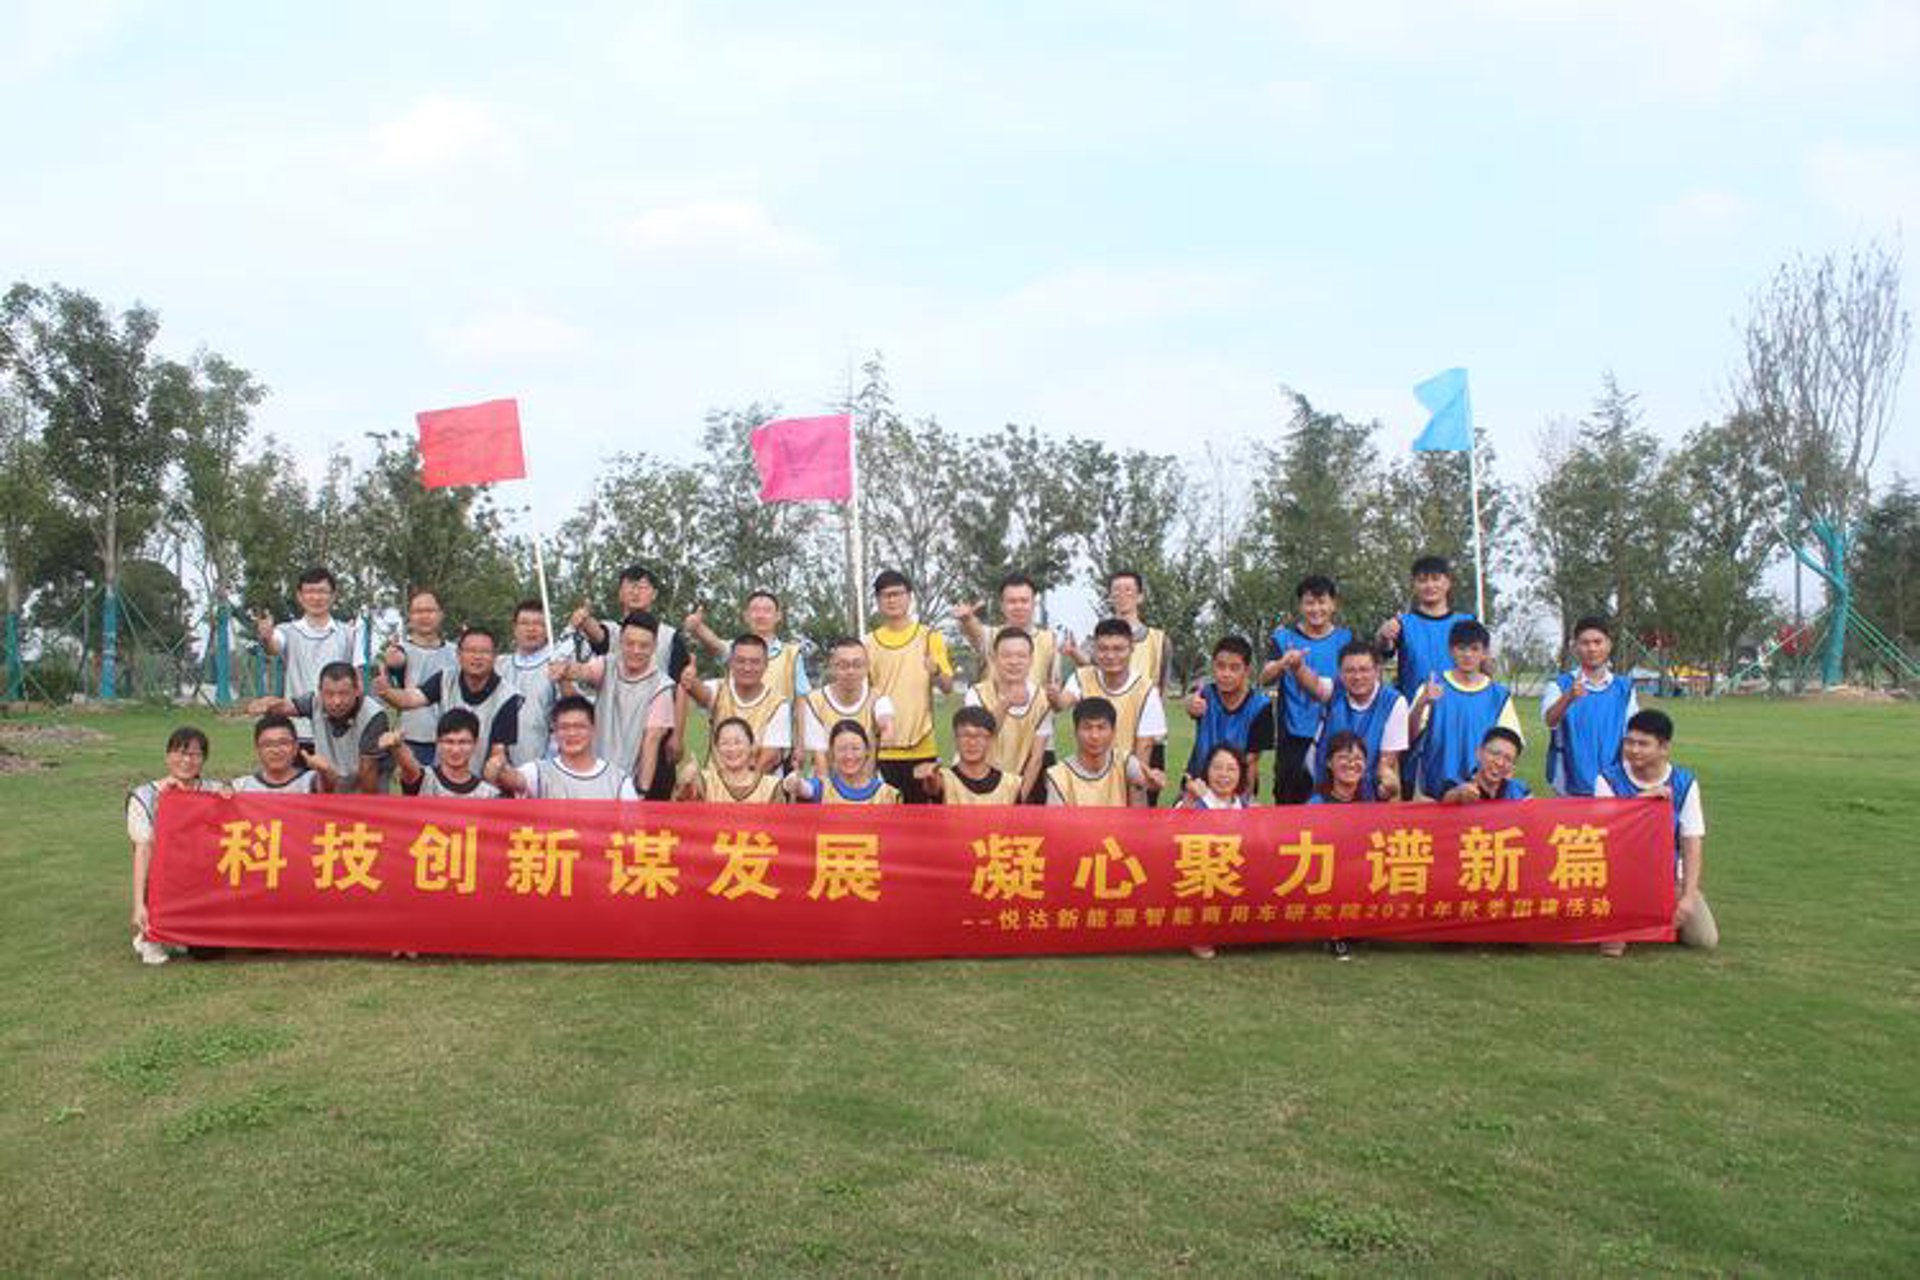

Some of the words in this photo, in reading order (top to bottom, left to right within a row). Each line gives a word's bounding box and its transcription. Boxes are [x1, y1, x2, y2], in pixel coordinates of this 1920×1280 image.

[216, 818, 882, 901] 科技创新谋发展
[971, 823, 1609, 901] 凝心聚力谱新篇
